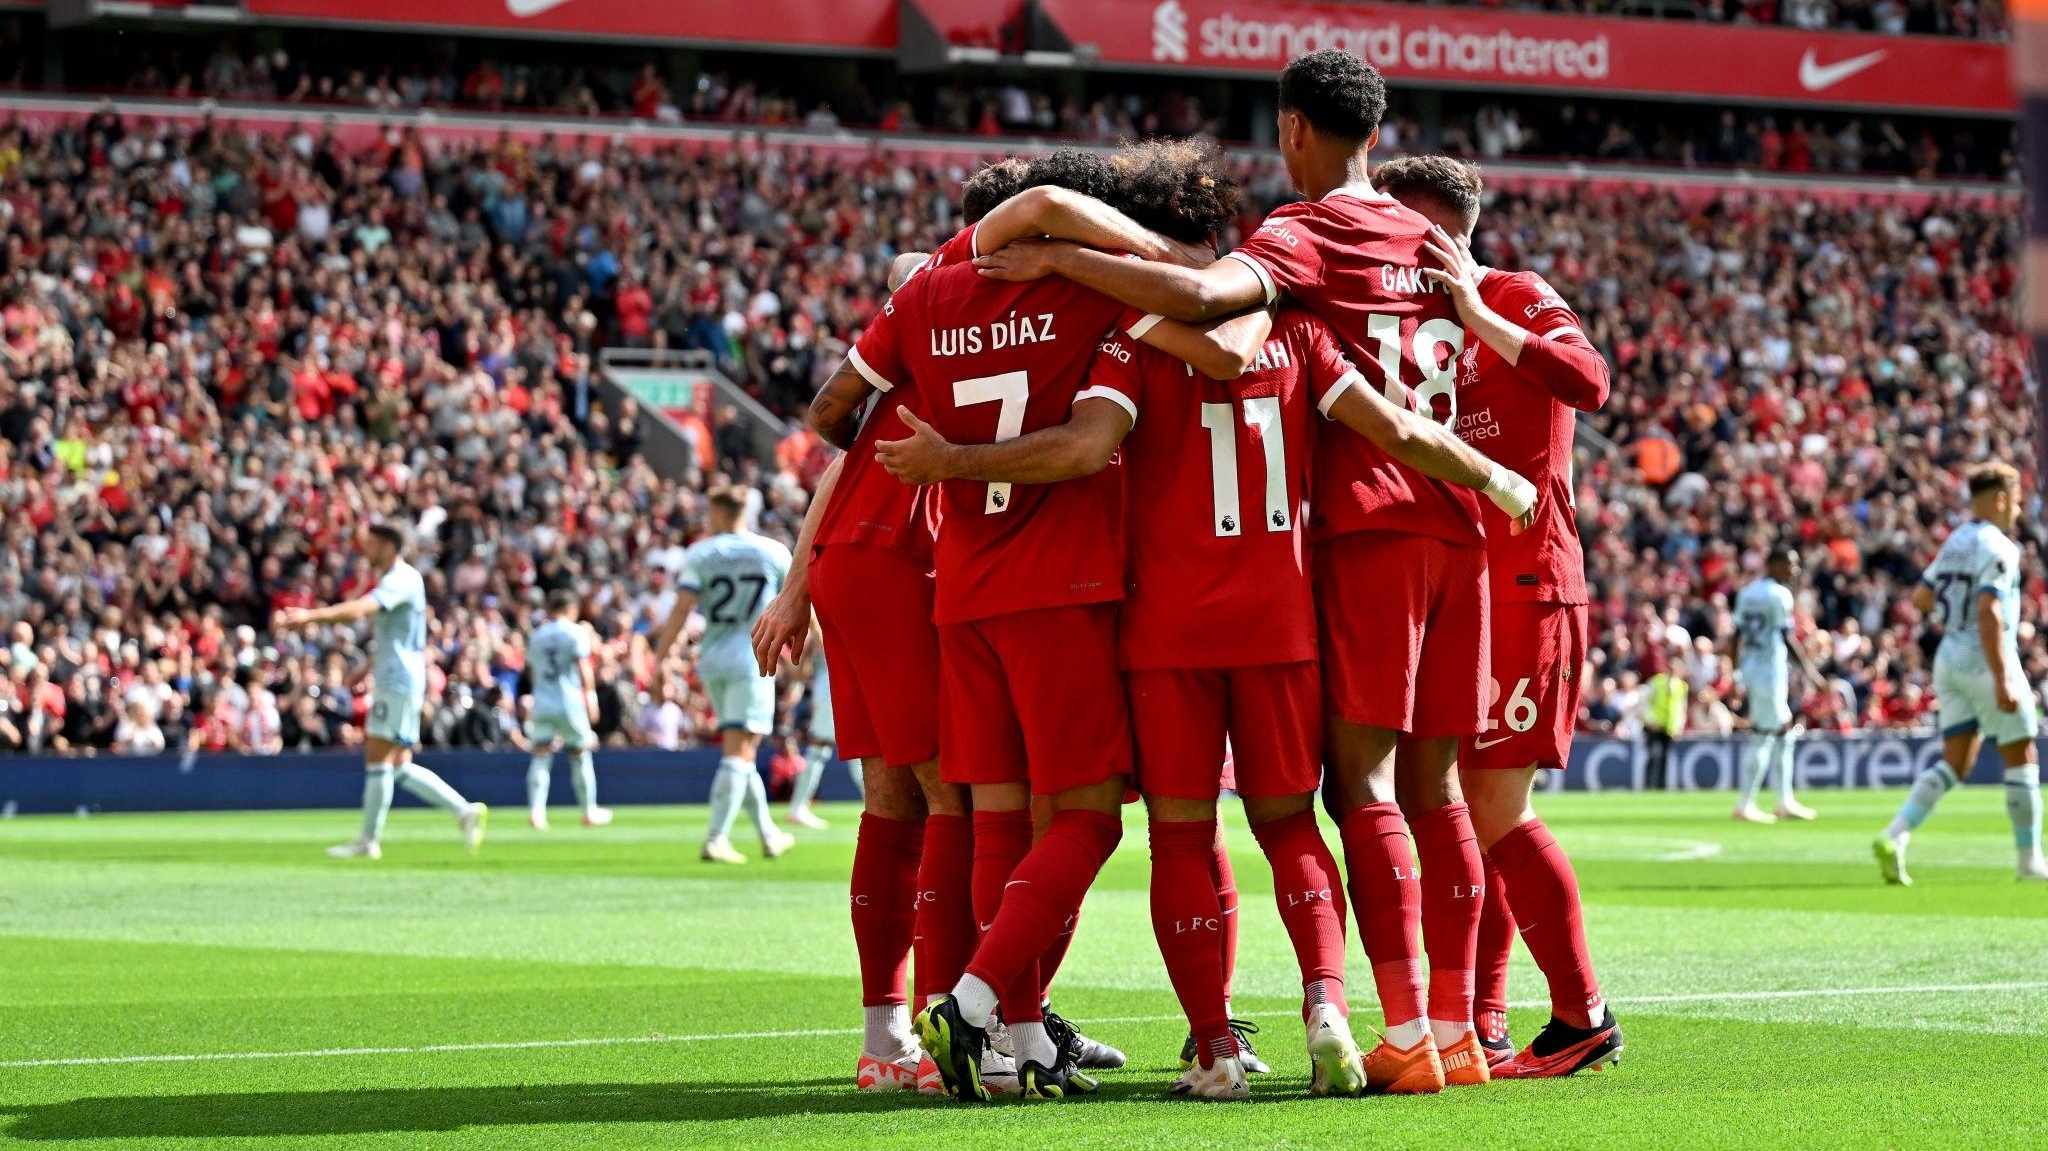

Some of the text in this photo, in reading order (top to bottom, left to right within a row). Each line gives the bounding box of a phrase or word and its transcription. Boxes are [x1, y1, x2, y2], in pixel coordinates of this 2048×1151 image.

[1200, 12, 1609, 78] standard chartered
[931, 310, 1056, 357] LUIS DÍAZ
[1367, 313, 1465, 432] 18
[952, 370, 1029, 515] 7
[1201, 396, 1292, 538] 11
[710, 573, 769, 623] 27
[1937, 573, 1973, 631] 37
